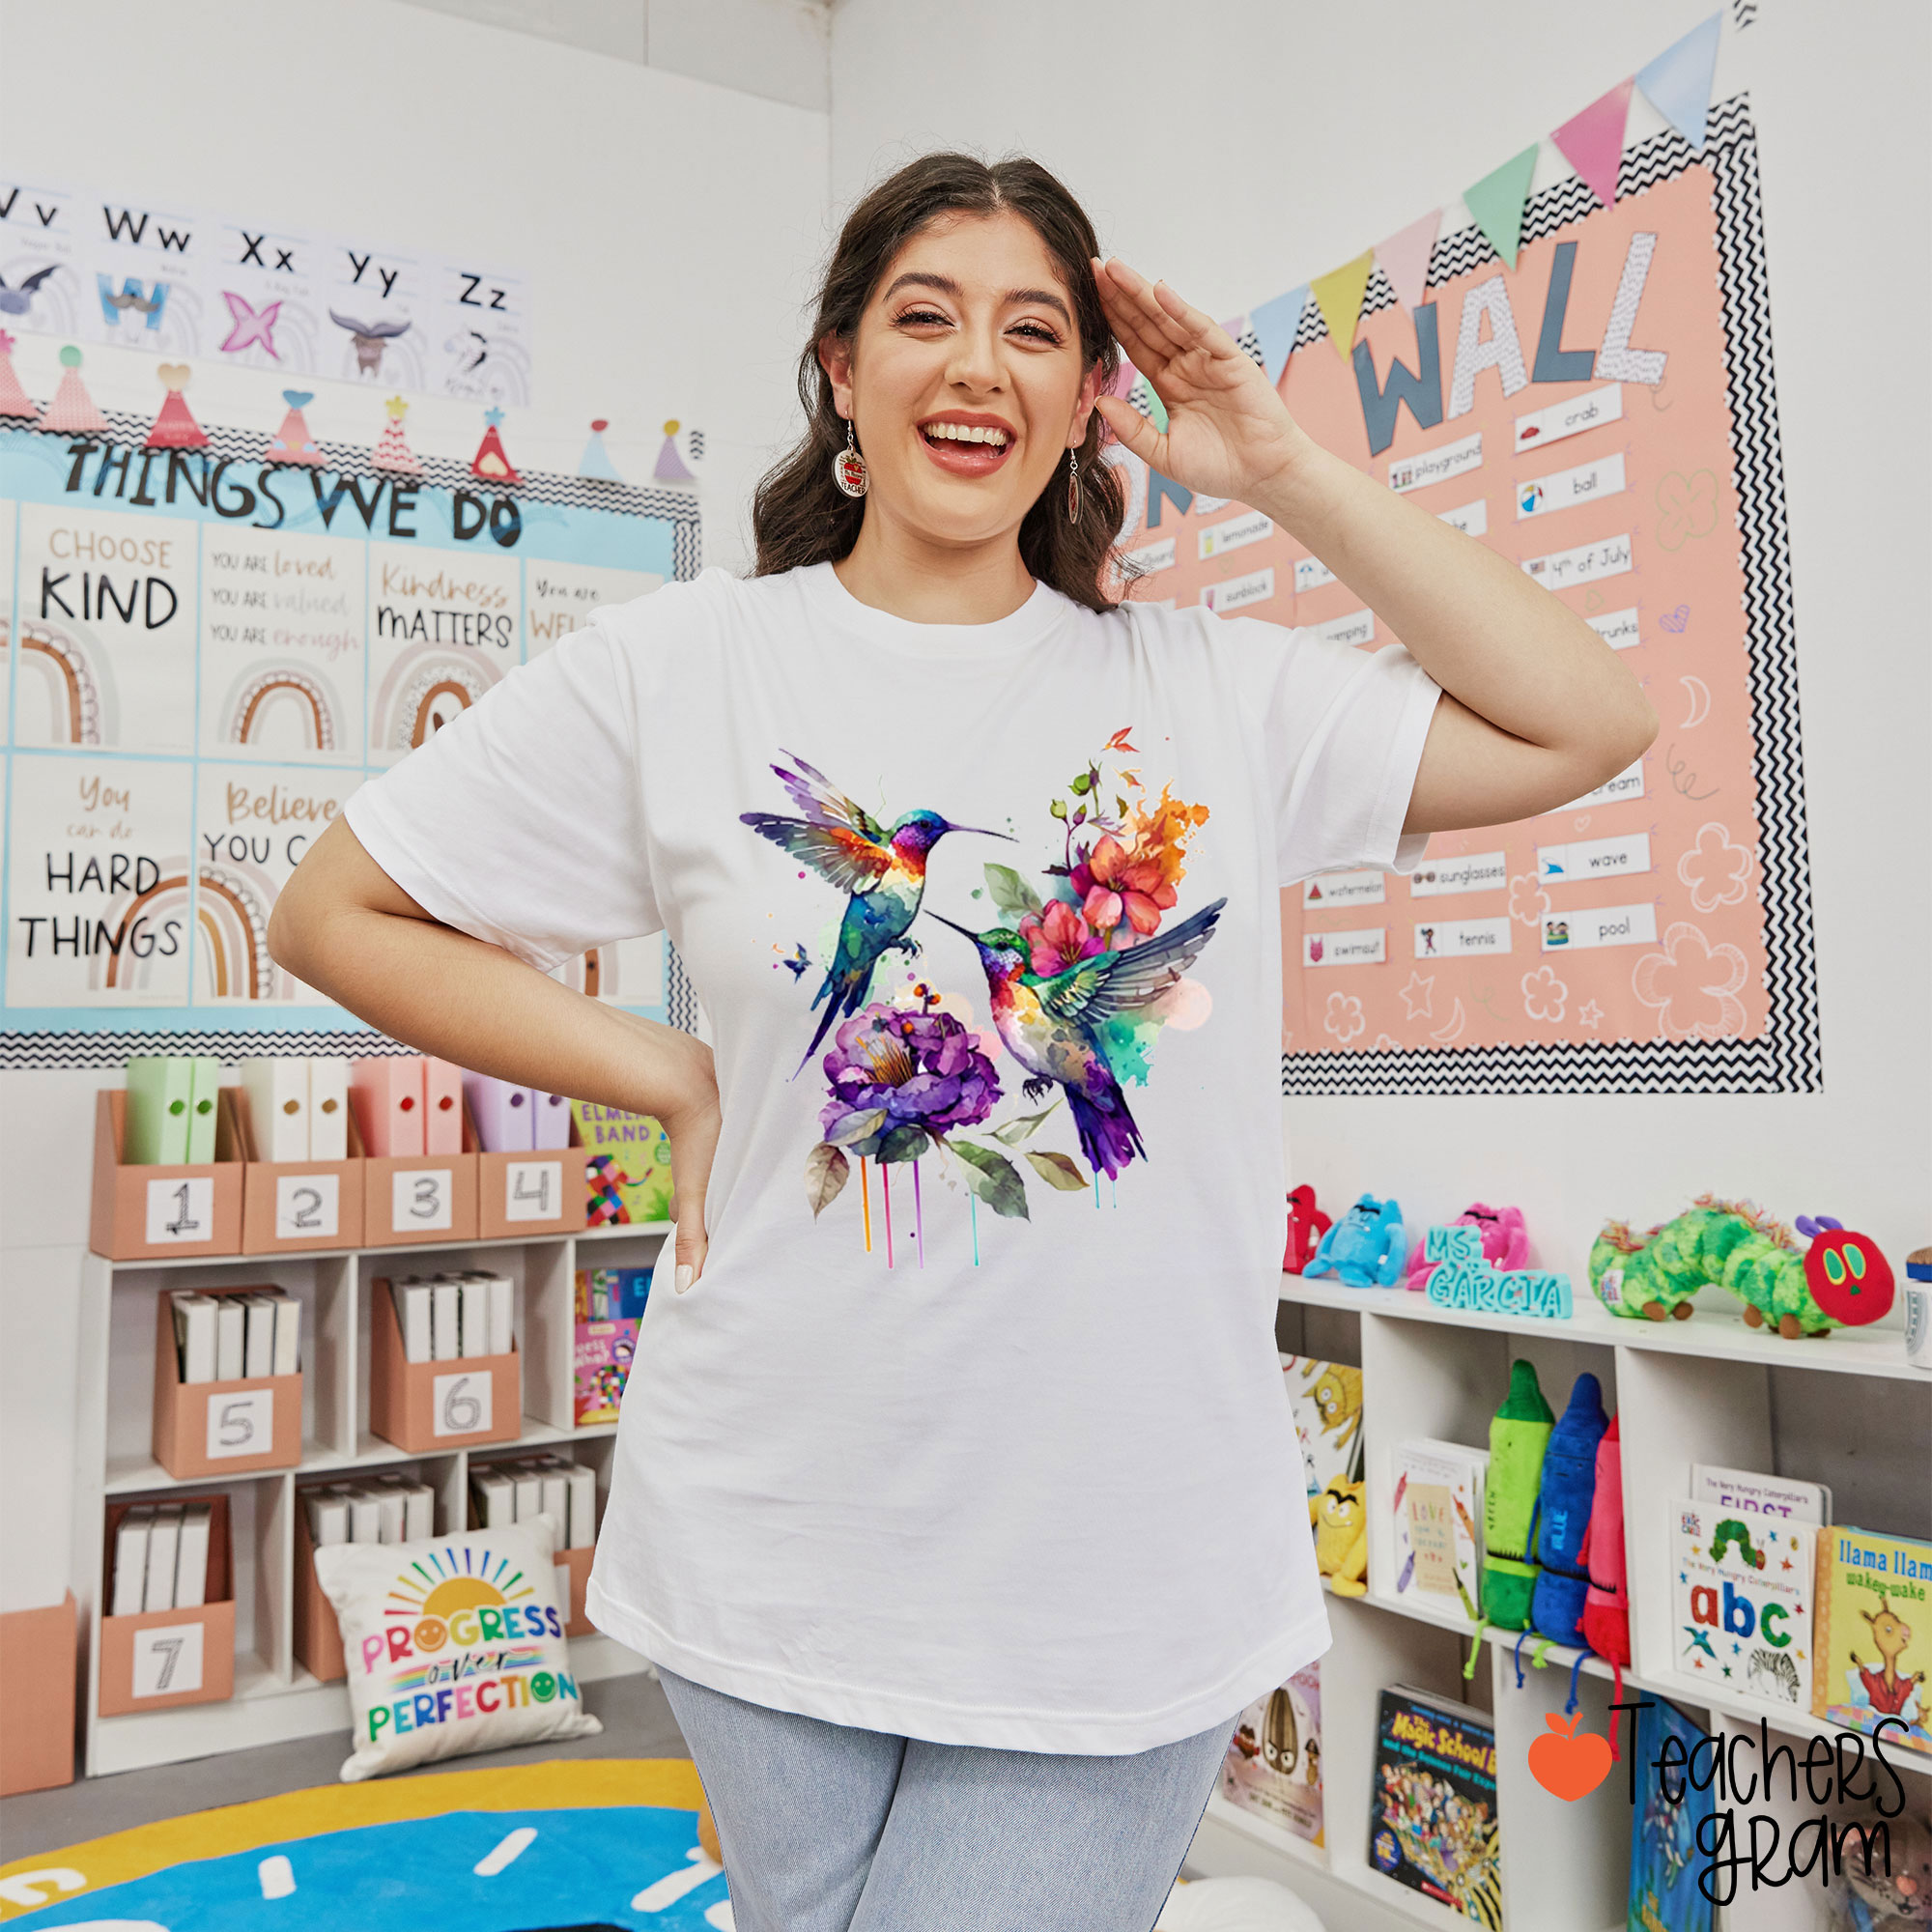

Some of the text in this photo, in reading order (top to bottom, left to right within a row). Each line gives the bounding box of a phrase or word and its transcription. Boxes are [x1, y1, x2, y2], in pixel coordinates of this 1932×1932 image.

[1352, 233, 1668, 457] WALL
[1565, 401, 1599, 427] crab
[1415, 440, 1482, 479] playground
[65, 443, 524, 549] THINGS WE DO
[1573, 471, 1598, 495] ball
[49, 528, 173, 570] CHOOSE
[211, 550, 335, 581] YOU ARE loved
[1577, 553, 1595, 572] of
[1600, 545, 1631, 567] July
[41, 566, 178, 630] KIND
[210, 587, 240, 606] YOU
[243, 591, 267, 609] ARE
[382, 561, 511, 609] Kindness
[210, 623, 360, 663] YOU ARE enough
[377, 606, 513, 648] MATTERS
[80, 776, 130, 811] You
[227, 781, 339, 825] Believe
[204, 834, 270, 864] YOU
[1589, 853, 1628, 868] wave
[46, 852, 160, 895] HARD
[1329, 881, 1384, 897] watermelon
[1439, 865, 1506, 886] sunglasses
[19, 916, 182, 958] THINGS
[1334, 941, 1379, 957] swimsuit
[1460, 931, 1496, 948] tennis
[1599, 916, 1632, 942] pool
[595, 1125, 650, 1145] BAND
[165, 1182, 200, 1236] 1
[290, 1186, 324, 1229] 2
[409, 1178, 441, 1219] 3
[513, 1169, 550, 1213] 4
[1427, 1228, 1471, 1262] MS
[1429, 1265, 1564, 1317] GARCIA
[220, 1401, 255, 1448] 5
[443, 1377, 482, 1432] 6
[1412, 1500, 1445, 1523] LOVE
[1838, 1539, 1889, 1573] llama
[1690, 1581, 1793, 1648] abc
[361, 1605, 563, 1676] PROGRESS
[150, 1637, 185, 1691] 7
[427, 1649, 517, 1687] over
[367, 1670, 579, 1743] PERFECTION
[1391, 1711, 1436, 1749] Magic
[1435, 1727, 1489, 1771] School
